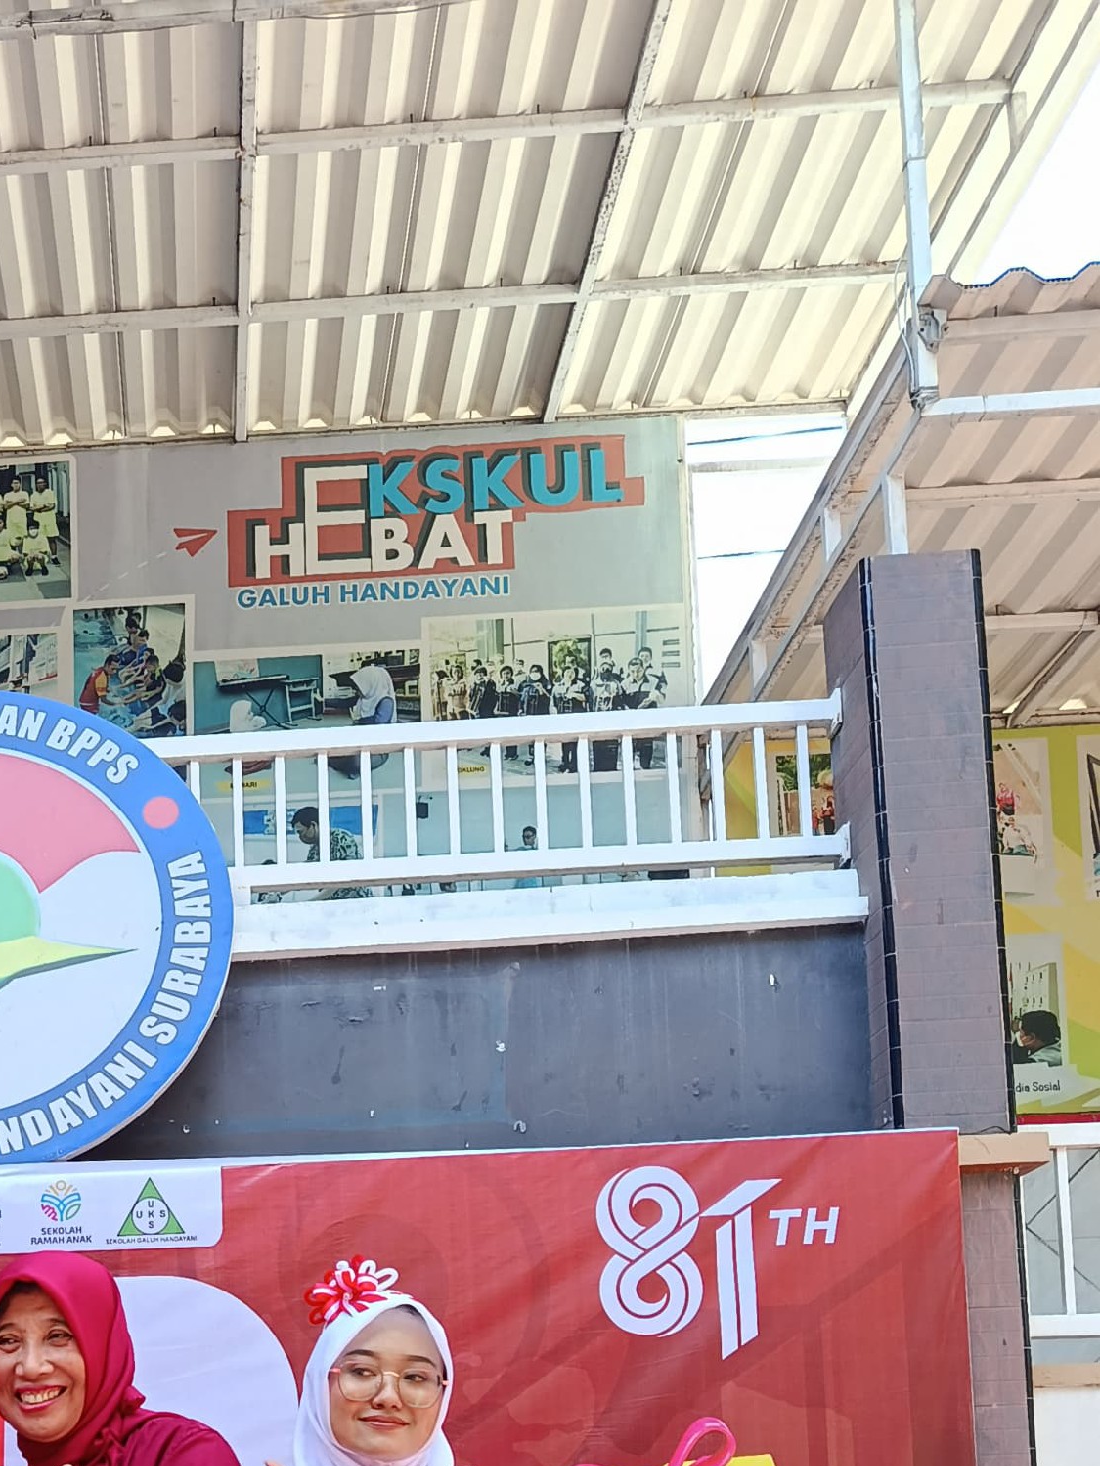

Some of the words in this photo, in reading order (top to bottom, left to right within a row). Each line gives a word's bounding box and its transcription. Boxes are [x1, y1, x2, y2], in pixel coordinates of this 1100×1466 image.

[254, 465, 513, 579] HEBAT
[237, 585, 331, 609] GALUH
[339, 575, 511, 604] HANDAYANI
[43, 717, 140, 786] BPPS
[139, 850, 213, 1047] SURABAYA
[1032, 1080, 1061, 1092] Sosial
[30, 1236, 65, 1245] RAMAH
[66, 1235, 92, 1244] ANAK
[41, 1226, 82, 1235] SEKOLAH
